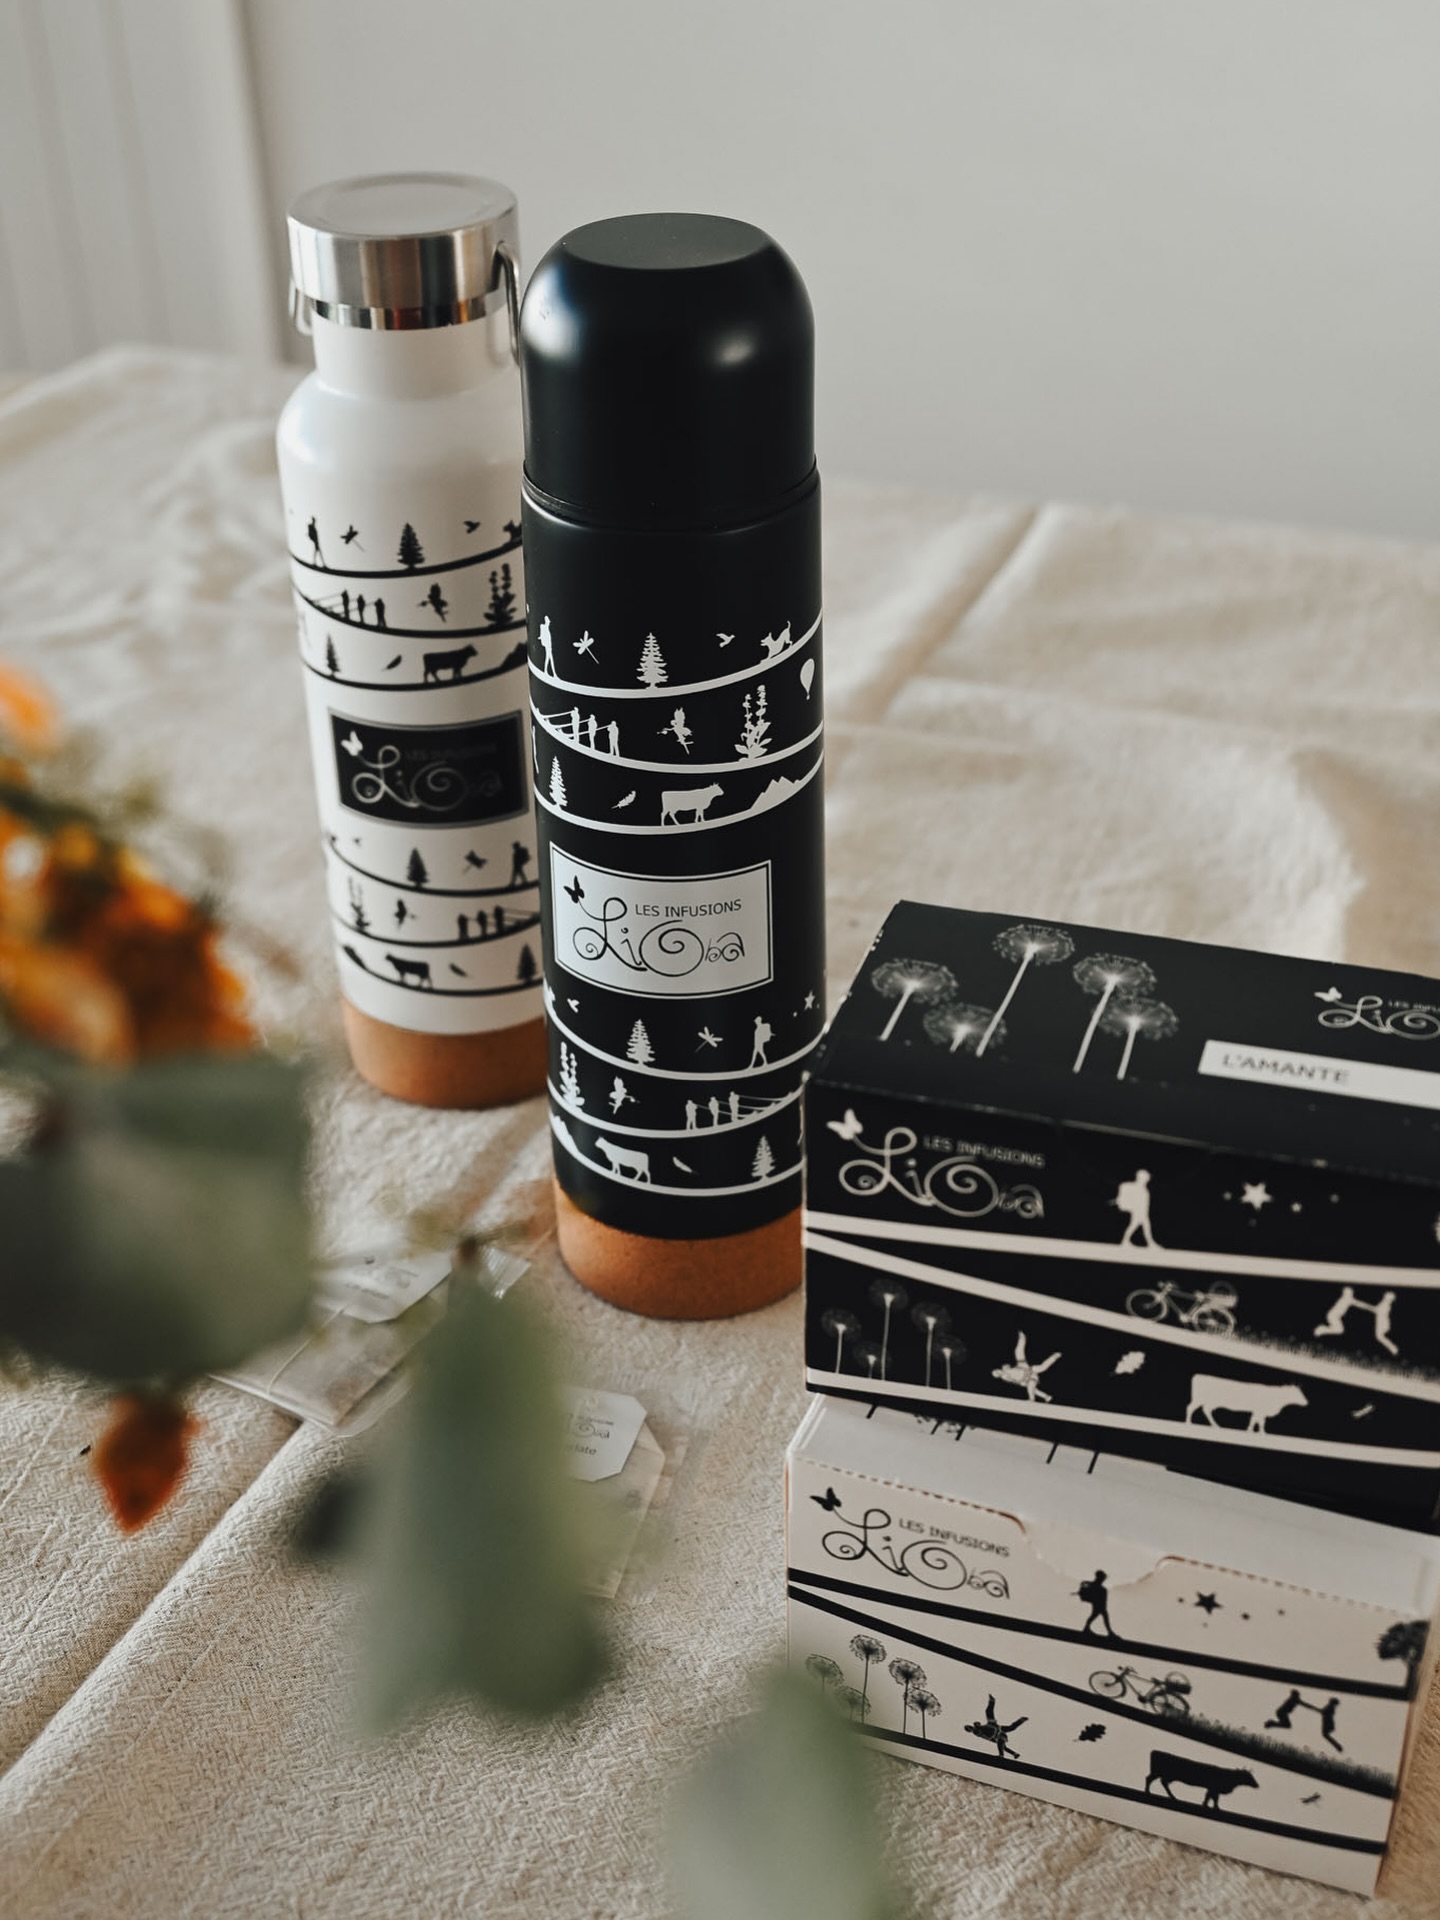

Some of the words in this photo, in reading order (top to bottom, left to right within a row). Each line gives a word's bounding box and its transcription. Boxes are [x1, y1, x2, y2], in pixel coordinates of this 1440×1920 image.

[635, 904, 660, 917] LES
[664, 899, 742, 917] INFUSIONS
[1222, 1053, 1350, 1084] L'AMANTE
[923, 1136, 953, 1151] LES
[956, 1140, 1046, 1169] INFUSIONS
[899, 1517, 925, 1534] LES
[929, 1526, 1011, 1558] INFUSIONS
